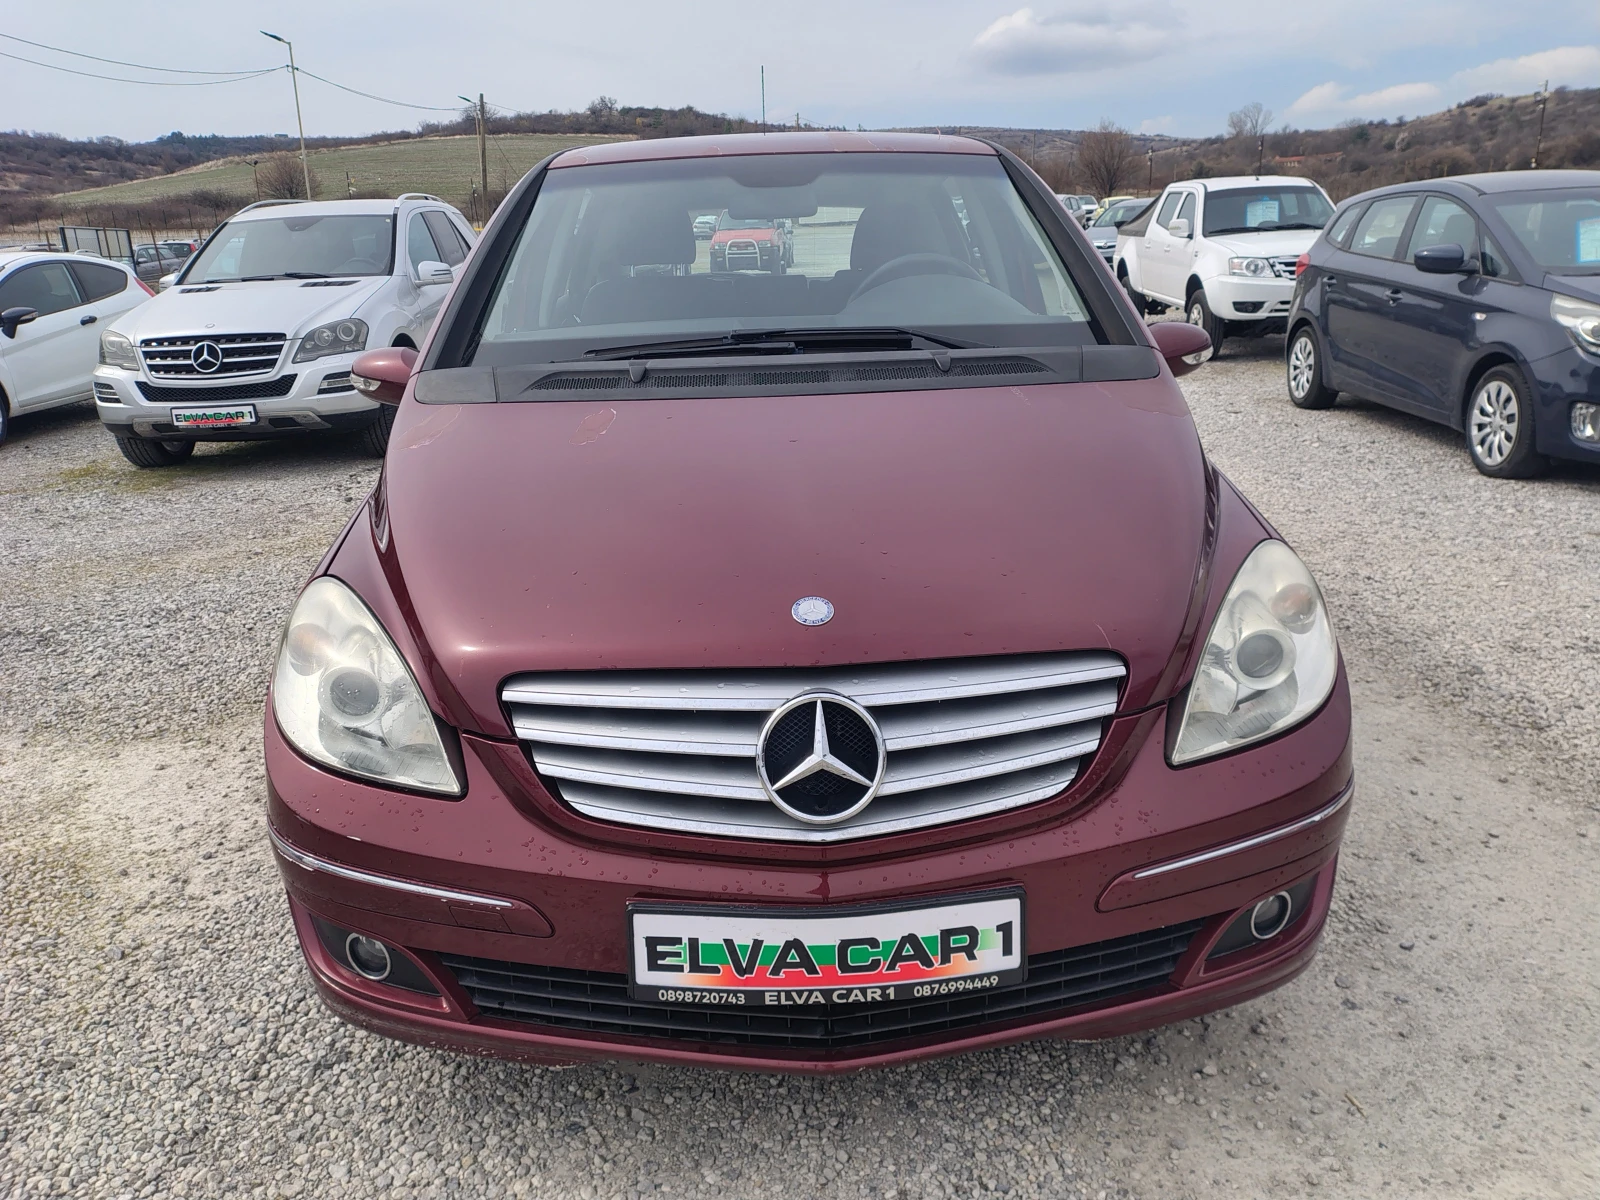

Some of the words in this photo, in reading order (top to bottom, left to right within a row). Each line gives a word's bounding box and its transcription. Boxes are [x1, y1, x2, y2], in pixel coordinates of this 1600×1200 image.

[174, 412, 210, 423] ELVA
[213, 411, 244, 421] CAR
[248, 410, 253, 419] 1
[644, 936, 820, 978] ELVA
[837, 925, 980, 974] CAR
[996, 920, 1013, 957] 1
[913, 975, 999, 997] 0876994449
[658, 989, 745, 1005] 0898720743
[764, 991, 826, 1005] ELVA
